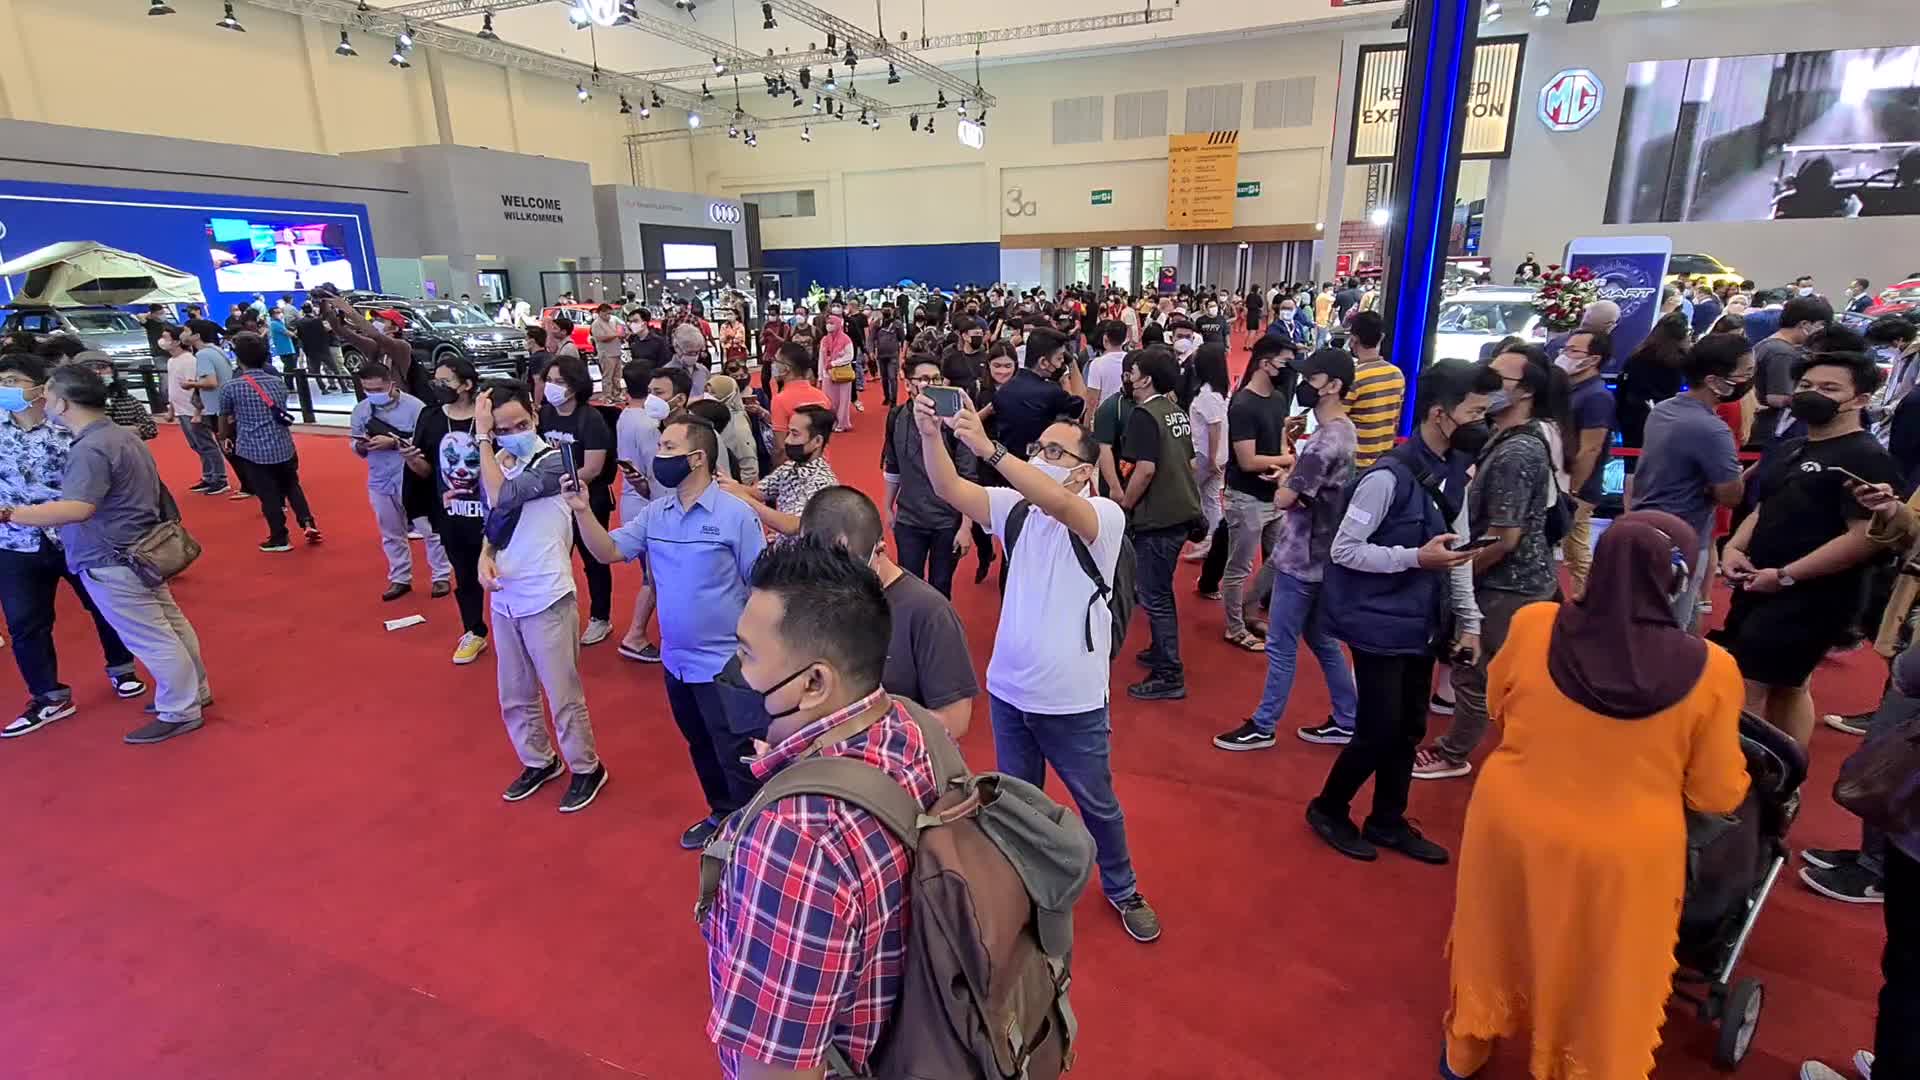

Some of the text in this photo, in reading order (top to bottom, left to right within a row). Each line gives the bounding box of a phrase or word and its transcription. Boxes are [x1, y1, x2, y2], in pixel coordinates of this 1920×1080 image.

[1545, 75, 1598, 124] MG
[501, 194, 562, 211] WELCOME
[1006, 186, 1037, 217] 3a
[504, 211, 564, 224] WILLKOMMEN
[1597, 287, 1656, 298] MART
[447, 500, 484, 517] JOKER
